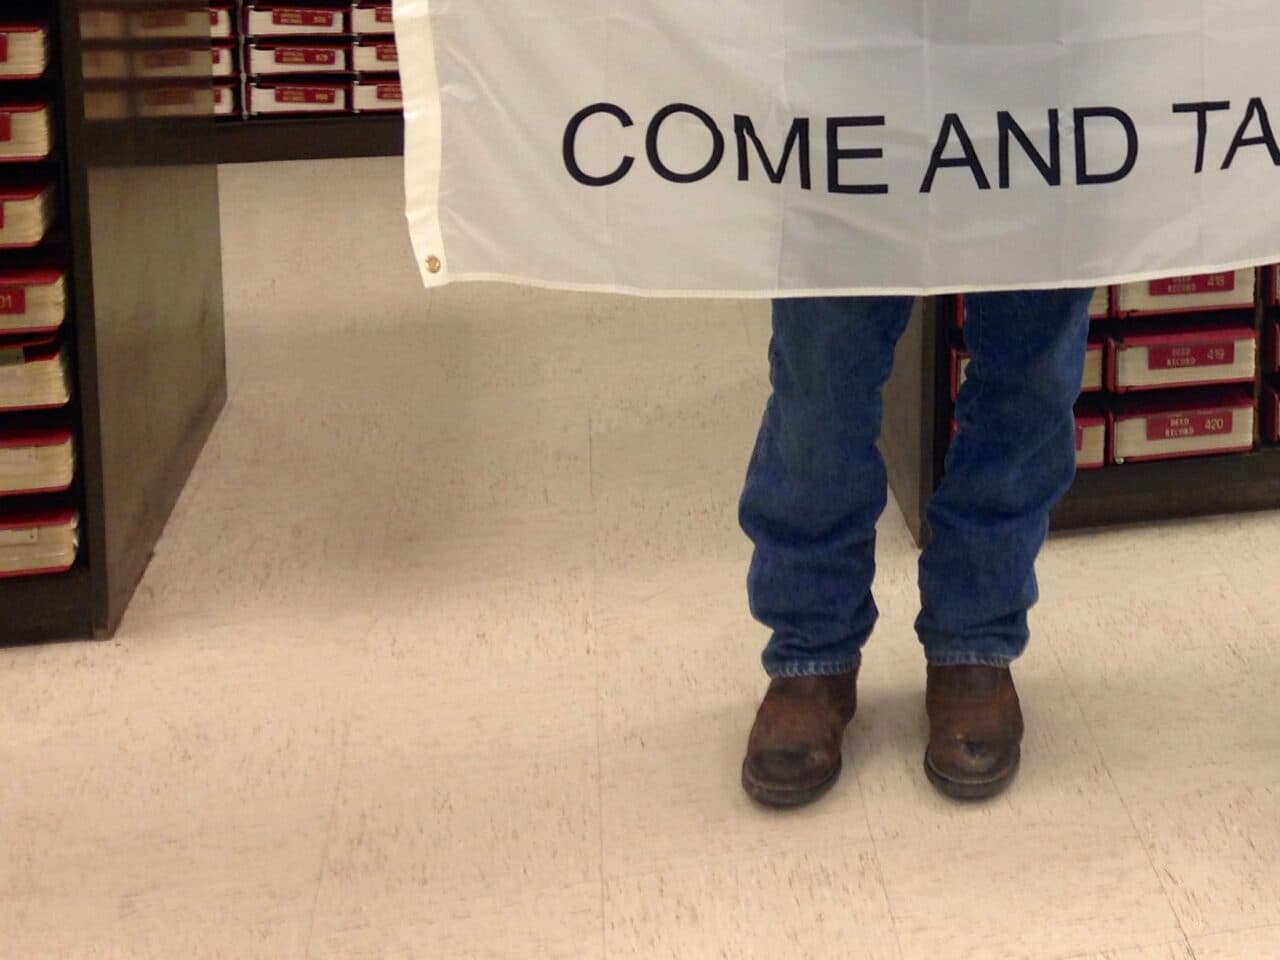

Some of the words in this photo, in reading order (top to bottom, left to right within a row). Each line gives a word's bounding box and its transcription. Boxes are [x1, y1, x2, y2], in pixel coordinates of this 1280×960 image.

[563, 103, 888, 194] COME
[919, 107, 1138, 193] AND
[1170, 417, 1190, 428] DEED
[1204, 418, 1224, 431] 420
[1165, 427, 1194, 438] RECORD
